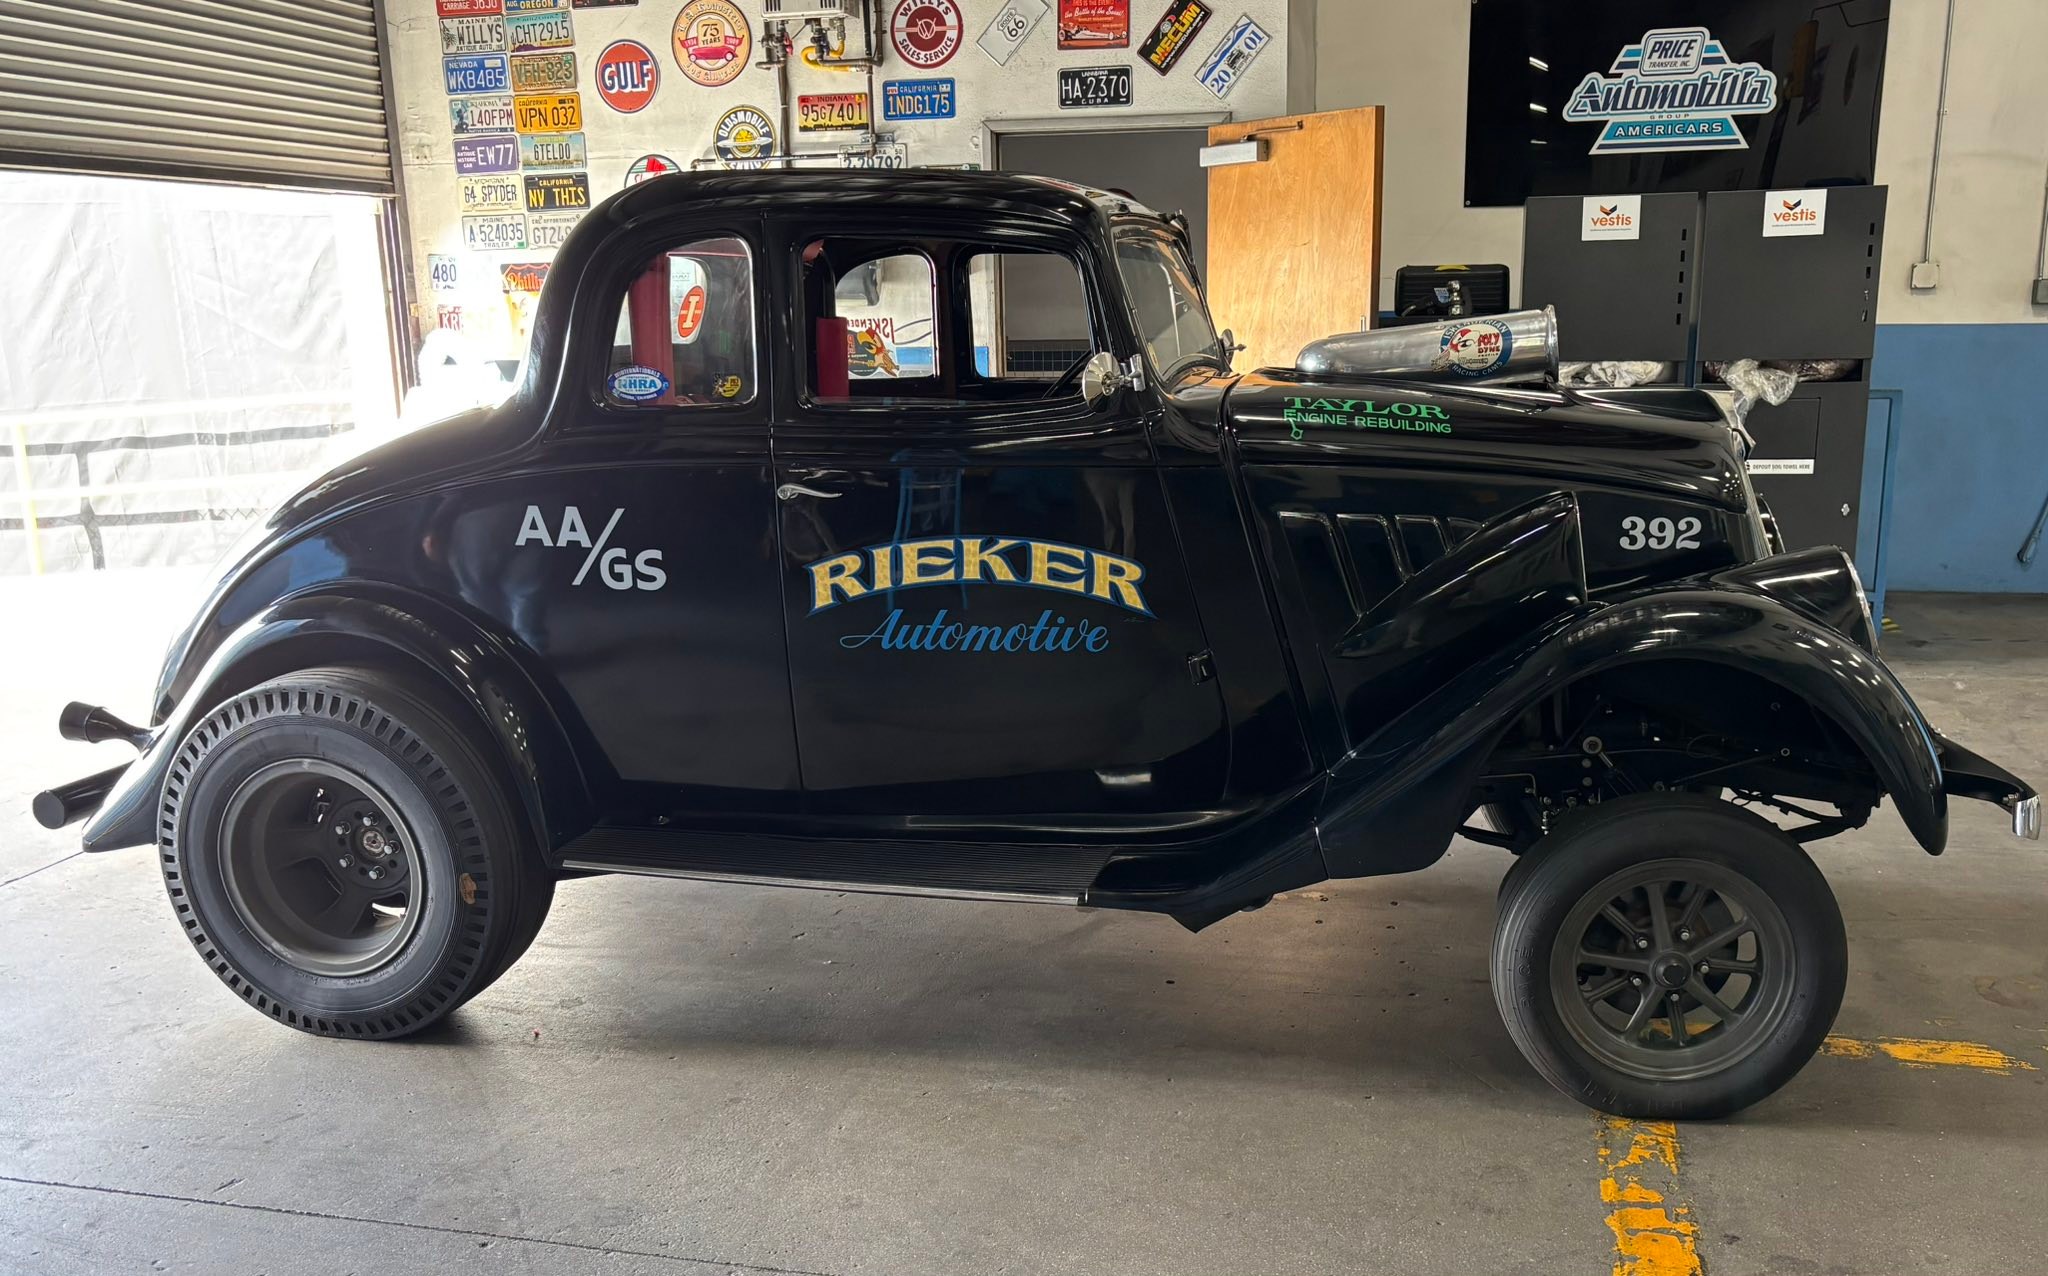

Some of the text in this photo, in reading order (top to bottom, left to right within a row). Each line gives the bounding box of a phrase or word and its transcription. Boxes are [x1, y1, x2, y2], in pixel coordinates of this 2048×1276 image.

[520, 0, 554, 8] OREGON
[1000, 11, 1014, 28] ROUTE
[1007, 18, 1025, 38] 66
[457, 24, 503, 45] WILLYS
[515, 20, 570, 43] CHT2915
[701, 23, 720, 38] 75
[1151, 2, 1201, 65] MECUM
[702, 37, 721, 45] YEARS
[899, 36, 955, 63] SALES-SERVICE
[1647, 39, 1698, 60] PRICE
[448, 61, 478, 69] NEVADA
[1210, 69, 1231, 93] 20
[1244, 30, 1264, 50] 01
[448, 69, 505, 90] WK8485
[602, 59, 652, 93] GULF
[899, 85, 937, 93] CALIFORNIA
[1571, 71, 1768, 113] Automobilia
[801, 102, 862, 122] 95G7401
[888, 94, 950, 115] 1NDG175
[519, 106, 577, 128] VPN 032
[718, 111, 770, 138] OLDSMOBILE
[1615, 122, 1723, 137] AMERICARS
[477, 143, 514, 165] EW77
[540, 178, 573, 186] CALIFORNIA
[481, 184, 517, 202] SPYDER
[553, 187, 586, 206] THIS
[1591, 213, 1632, 226] vestis
[1773, 208, 1816, 222] vestis
[479, 223, 523, 242] 524035
[1444, 320, 1510, 340] ISKENDERIAN
[1478, 333, 1500, 346] POLY
[1452, 361, 1503, 376] RACING CAMS
[618, 379, 657, 389] NHRA
[1284, 397, 1450, 419] TAYLOR
[1284, 409, 1452, 434] ENGINE REBUILDING
[1619, 515, 1702, 551] 392
[808, 537, 1152, 613] RIEKER
[840, 609, 1109, 652] Automotive
